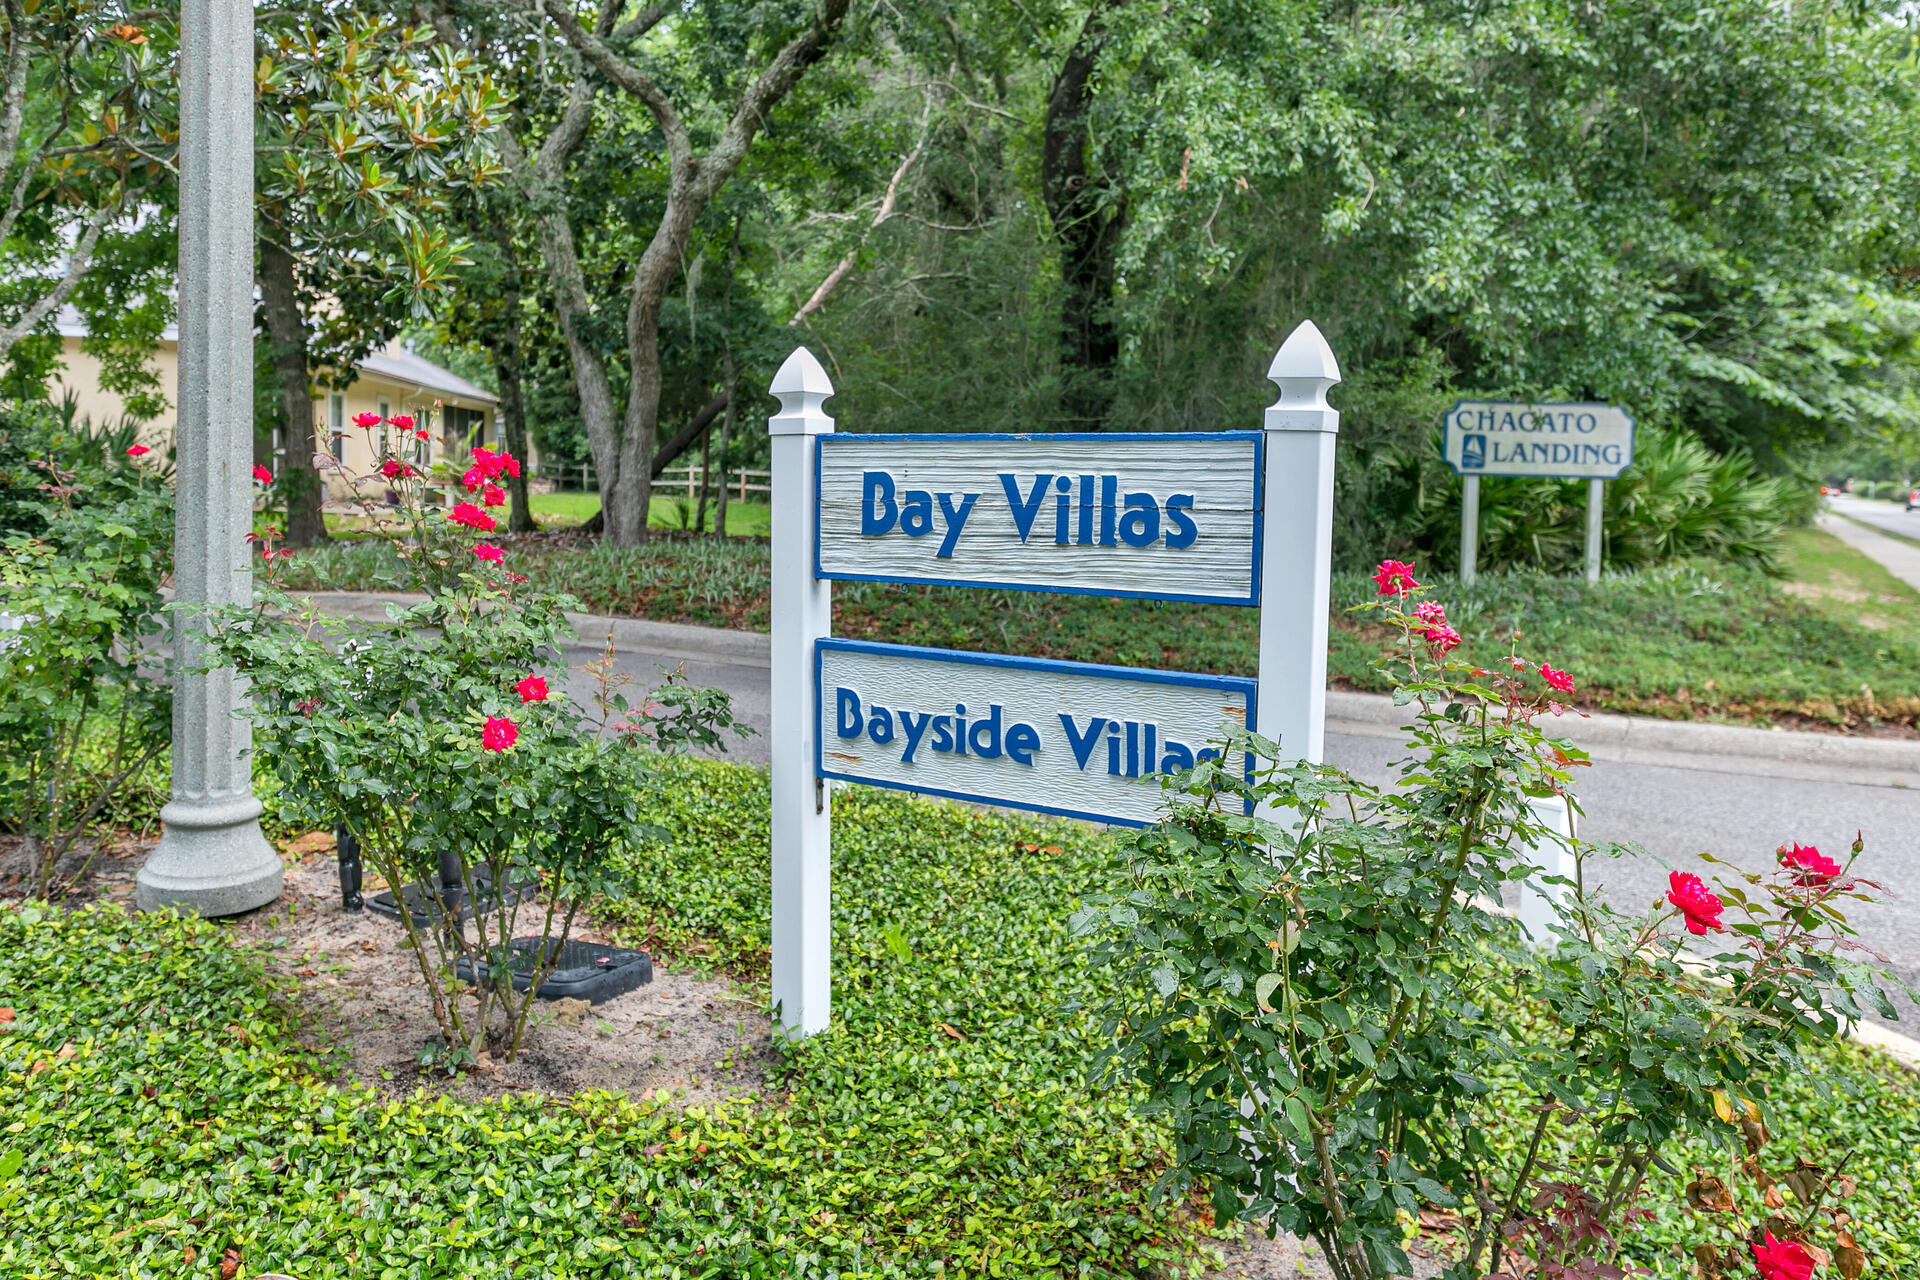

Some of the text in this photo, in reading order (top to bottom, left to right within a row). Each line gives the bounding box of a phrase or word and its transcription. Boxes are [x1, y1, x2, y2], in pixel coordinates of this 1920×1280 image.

[1492, 442, 1622, 465] LANDING
[861, 471, 1199, 558] Bay Villas
[836, 687, 1041, 767] Bayside
